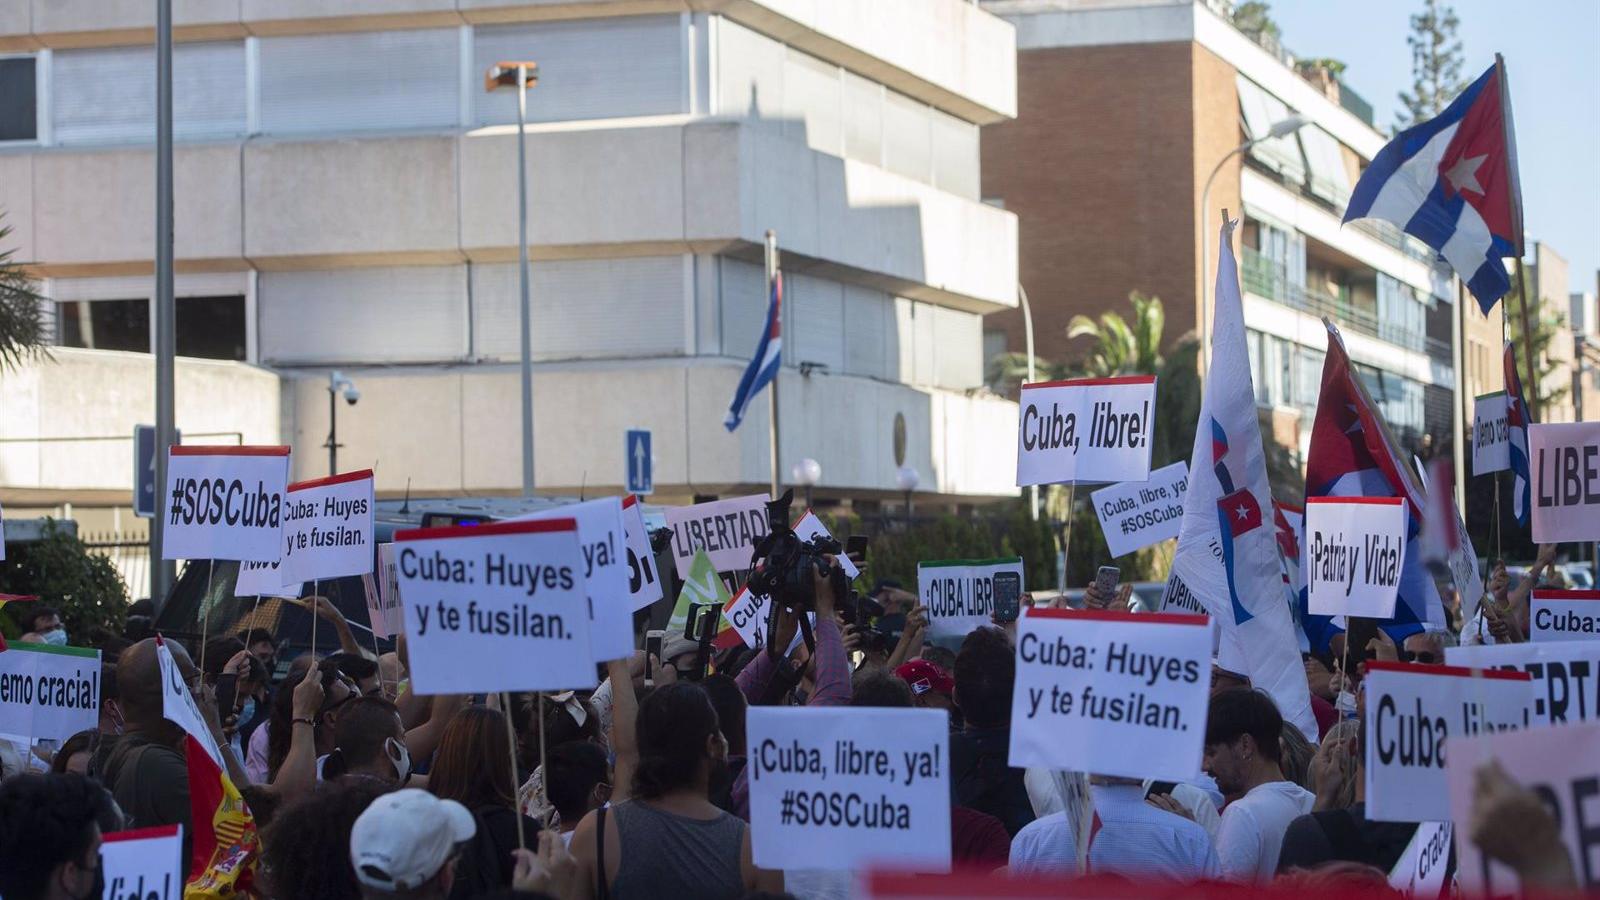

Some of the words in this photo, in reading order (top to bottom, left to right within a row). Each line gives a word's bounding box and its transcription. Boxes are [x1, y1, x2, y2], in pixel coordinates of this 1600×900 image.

[1022, 403, 1080, 455] Cuba,
[1088, 400, 1149, 449] libre!
[170, 478, 281, 528] #SOSCuba
[323, 496, 367, 521] Huyes
[1100, 497, 1140, 522] ¡Cuba,
[1139, 487, 1171, 505] libre,
[1120, 504, 1184, 536] #SOSCuba
[286, 535, 294, 556] y
[296, 530, 307, 550] te
[310, 526, 365, 548] fusilan.
[582, 531, 616, 579] ya!
[1310, 531, 1346, 594] ¡Patria
[1346, 546, 1360, 597] y
[1365, 533, 1402, 587] Vida!
[401, 547, 474, 583] Cuba:
[485, 553, 574, 596] Huyes
[415, 604, 429, 636] y
[437, 596, 460, 632] te
[468, 601, 573, 640] fusilan.
[926, 578, 964, 626] ¡CUBA
[966, 577, 994, 616] LIBR
[1535, 608, 1600, 633] Cuba:
[1020, 632, 1096, 670] Cuba:
[1105, 642, 1199, 686] Huyes
[37, 669, 97, 709] cracia!
[1028, 688, 1043, 719] y
[1051, 685, 1073, 715] te
[1080, 687, 1188, 731] fusilan.
[753, 738, 827, 780] ¡Cuba,
[834, 740, 895, 783] libre,
[903, 744, 940, 786] ya!
[781, 790, 910, 830] #SOSCuba
